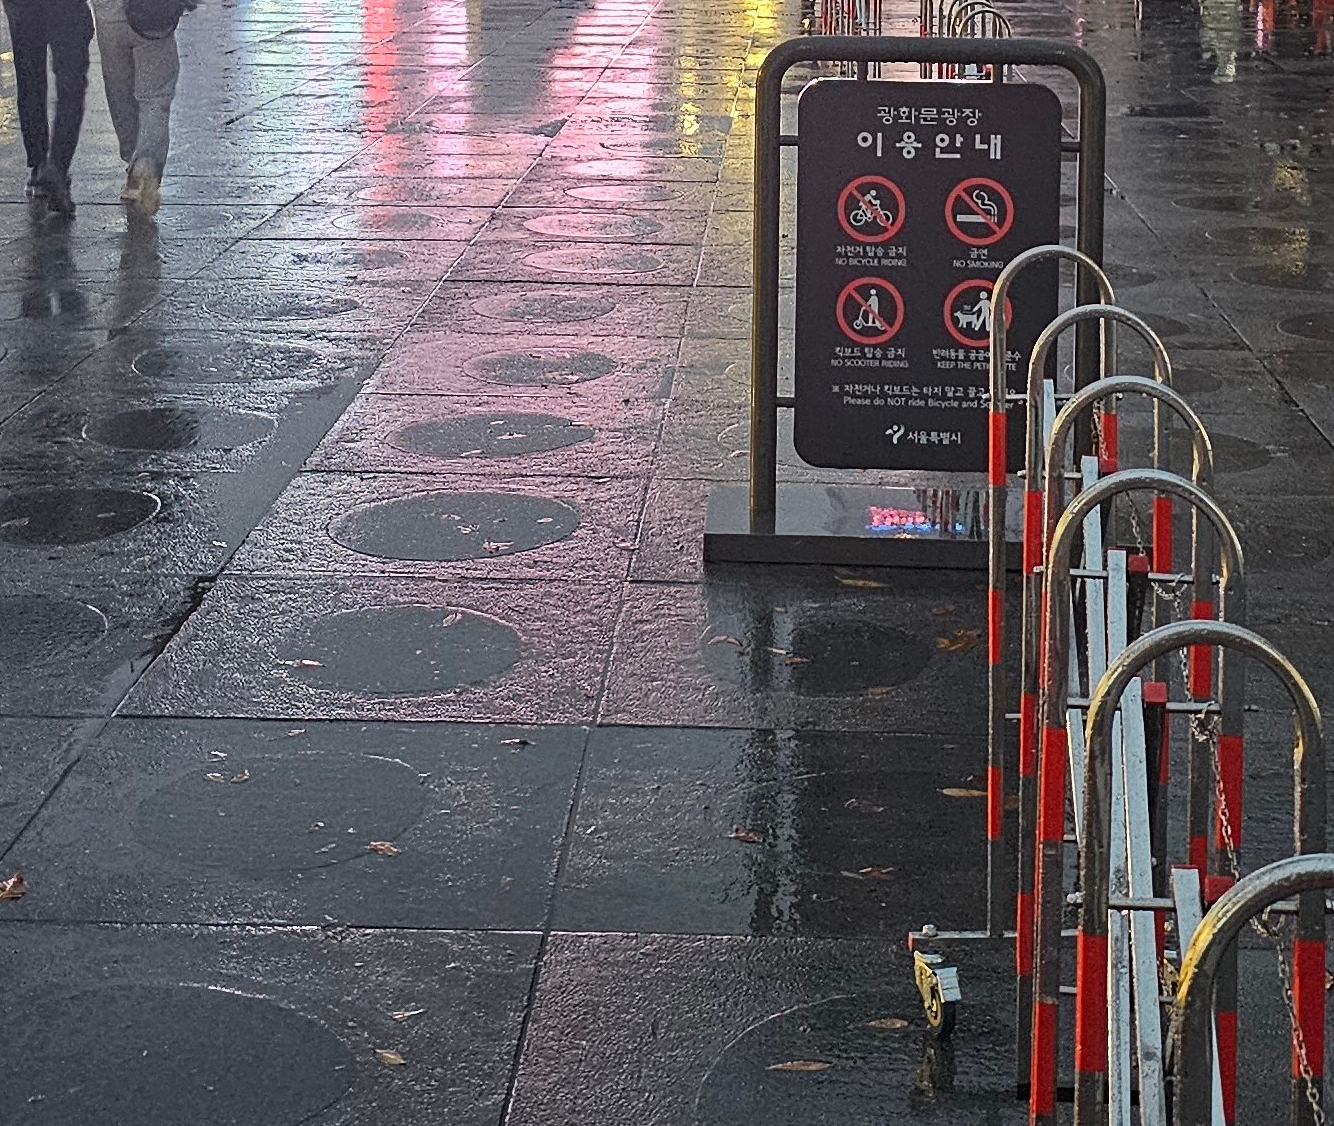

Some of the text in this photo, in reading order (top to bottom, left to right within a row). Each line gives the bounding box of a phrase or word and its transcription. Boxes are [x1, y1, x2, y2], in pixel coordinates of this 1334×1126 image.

[876, 106, 982, 126] 광화문광장
[835, 245, 907, 257] 자전거 탑승 금지
[969, 247, 988, 259] 금연
[835, 257, 907, 267] NO BICYCLE RIDING
[953, 259, 1004, 269] NO SMOKING
[835, 346, 906, 358] 킥보드 탑승 금지
[932, 348, 966, 360] 반려동물
[831, 359, 909, 368] NO SCOOTER RIDING
[937, 361, 956, 369] KEEP
[957, 361, 972, 369] THE
[843, 383, 881, 395] 자전거나
[884, 385, 920, 396] 킥보드는
[923, 385, 942, 396] 타지
[945, 386, 964, 397] 말고
[967, 386, 985, 398] 끌고
[843, 396, 871, 405] Please
[873, 397, 885, 406] do
[887, 397, 906, 406] NOT
[908, 398, 925, 407] ride
[927, 398, 959, 409] Bicycle
[961, 400, 977, 408] and
[907, 430, 961, 445] 서울특별시
